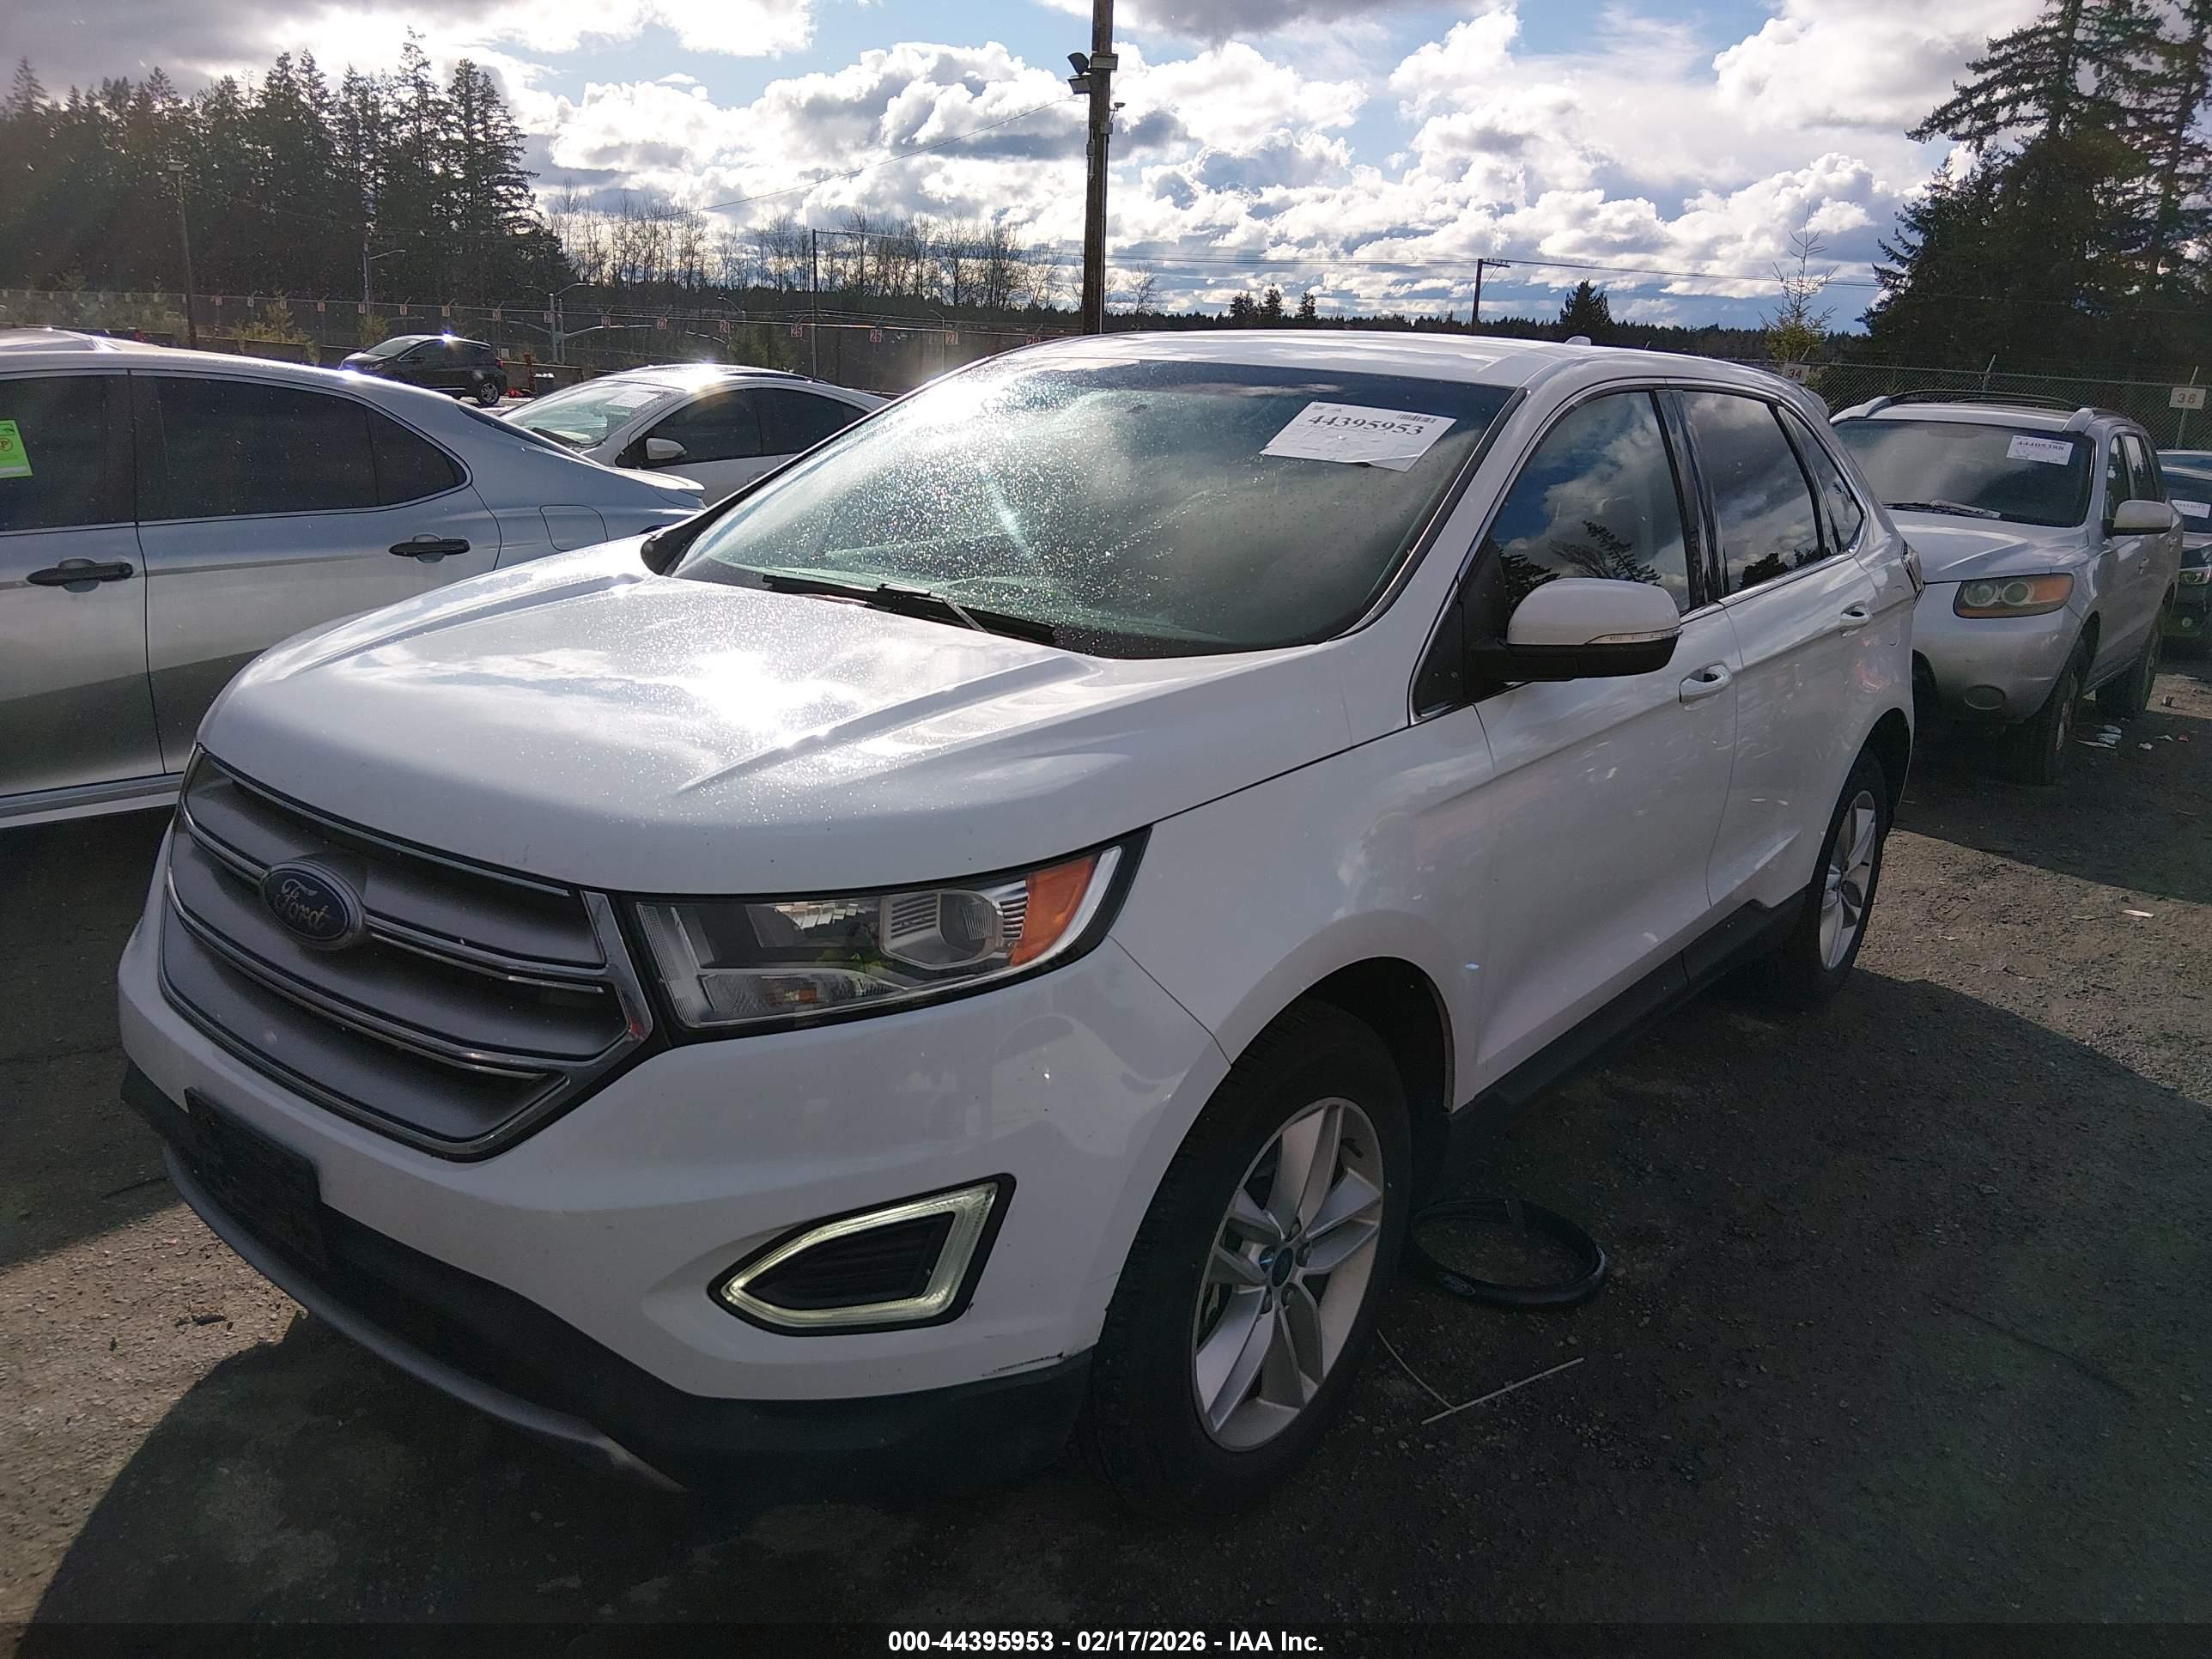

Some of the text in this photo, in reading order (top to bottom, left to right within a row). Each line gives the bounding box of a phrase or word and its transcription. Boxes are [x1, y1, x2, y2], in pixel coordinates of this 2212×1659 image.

[792, 325, 801, 336] 25
[871, 330, 880, 342] 26
[947, 331, 957, 344] 27
[1788, 368, 1802, 379] 34
[1308, 414, 1424, 435] 44395953
[275, 878, 330, 929] Ford
